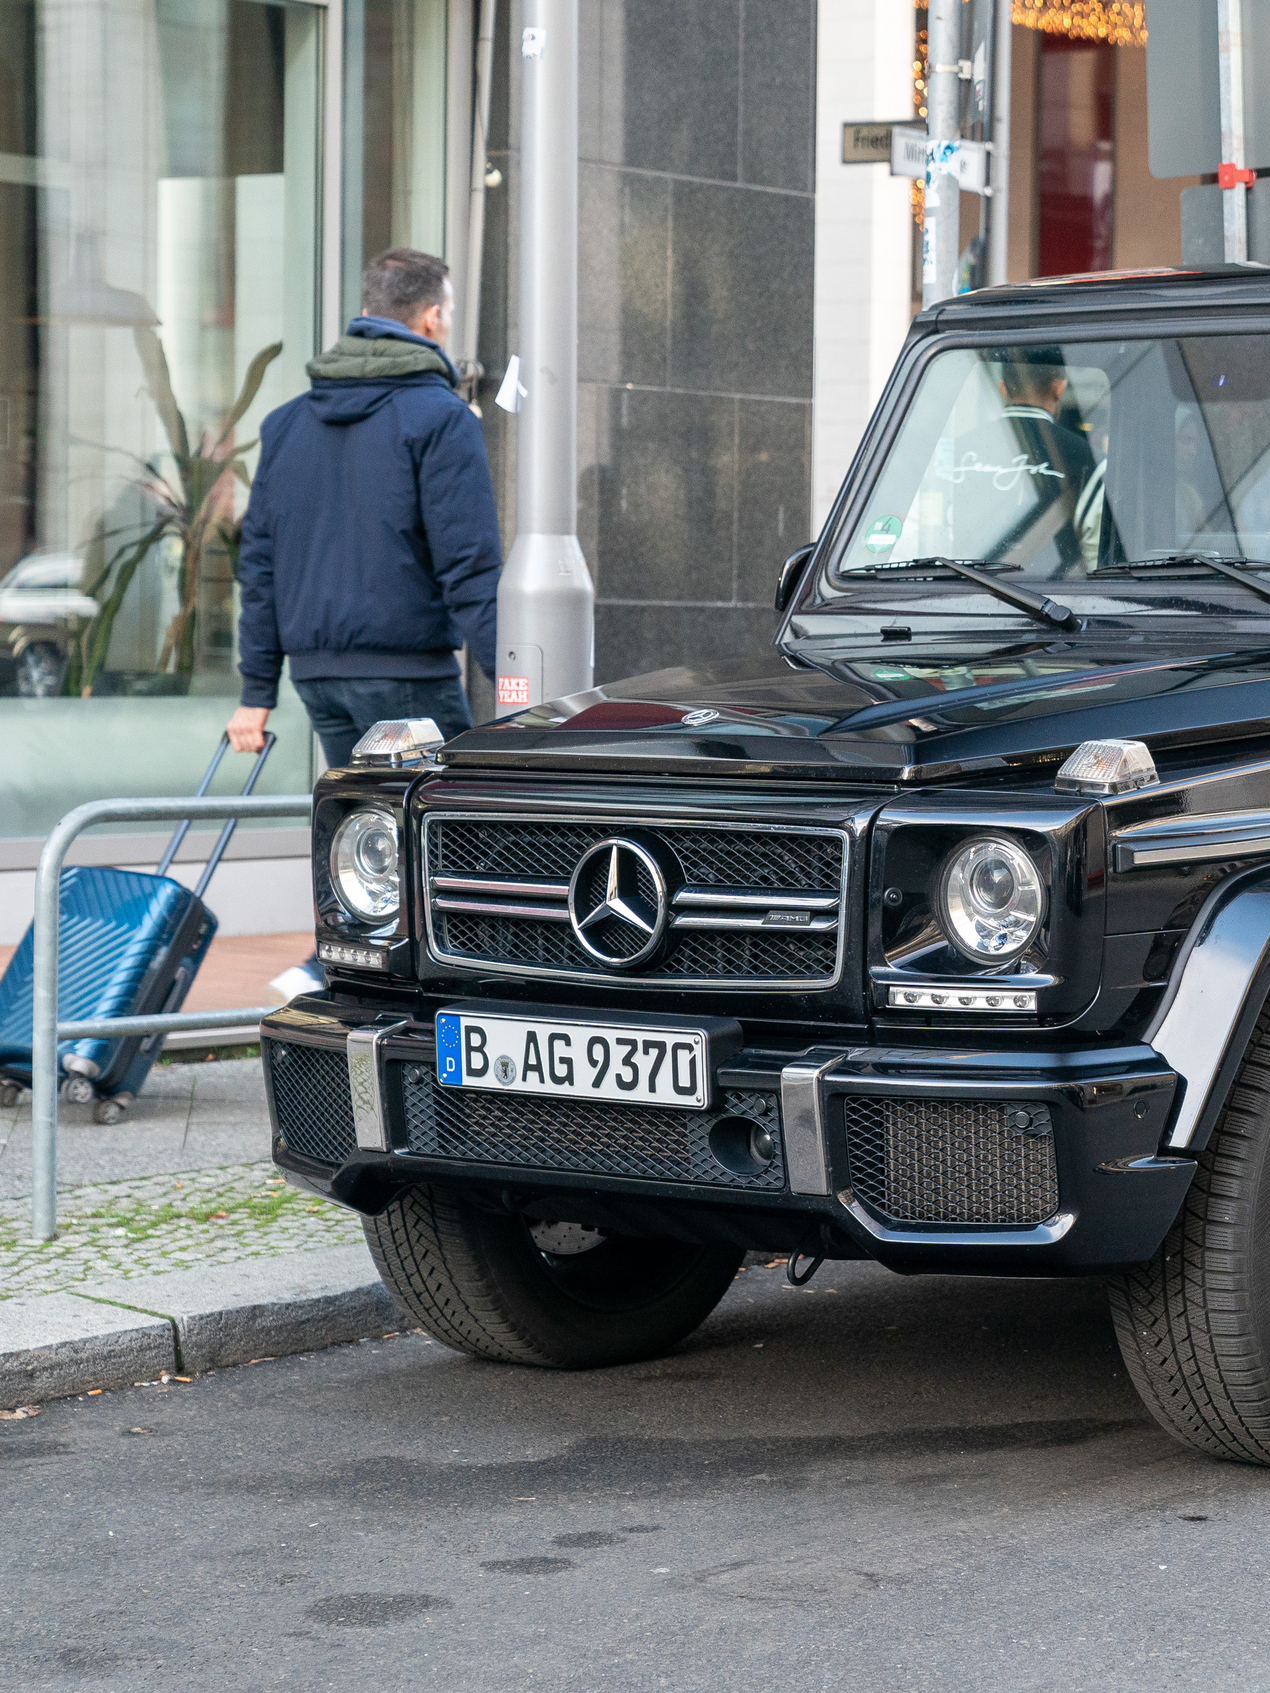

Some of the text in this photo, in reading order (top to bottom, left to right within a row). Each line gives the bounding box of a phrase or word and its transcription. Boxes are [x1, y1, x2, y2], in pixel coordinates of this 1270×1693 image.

[853, 128, 891, 149] Fried
[880, 516, 892, 534] 4
[498, 677, 528, 690] FAKE
[498, 690, 528, 702] YEAH
[445, 1057, 456, 1072] D
[464, 1025, 489, 1077] B
[521, 1030, 574, 1086] AG
[586, 1035, 698, 1096] 9370
